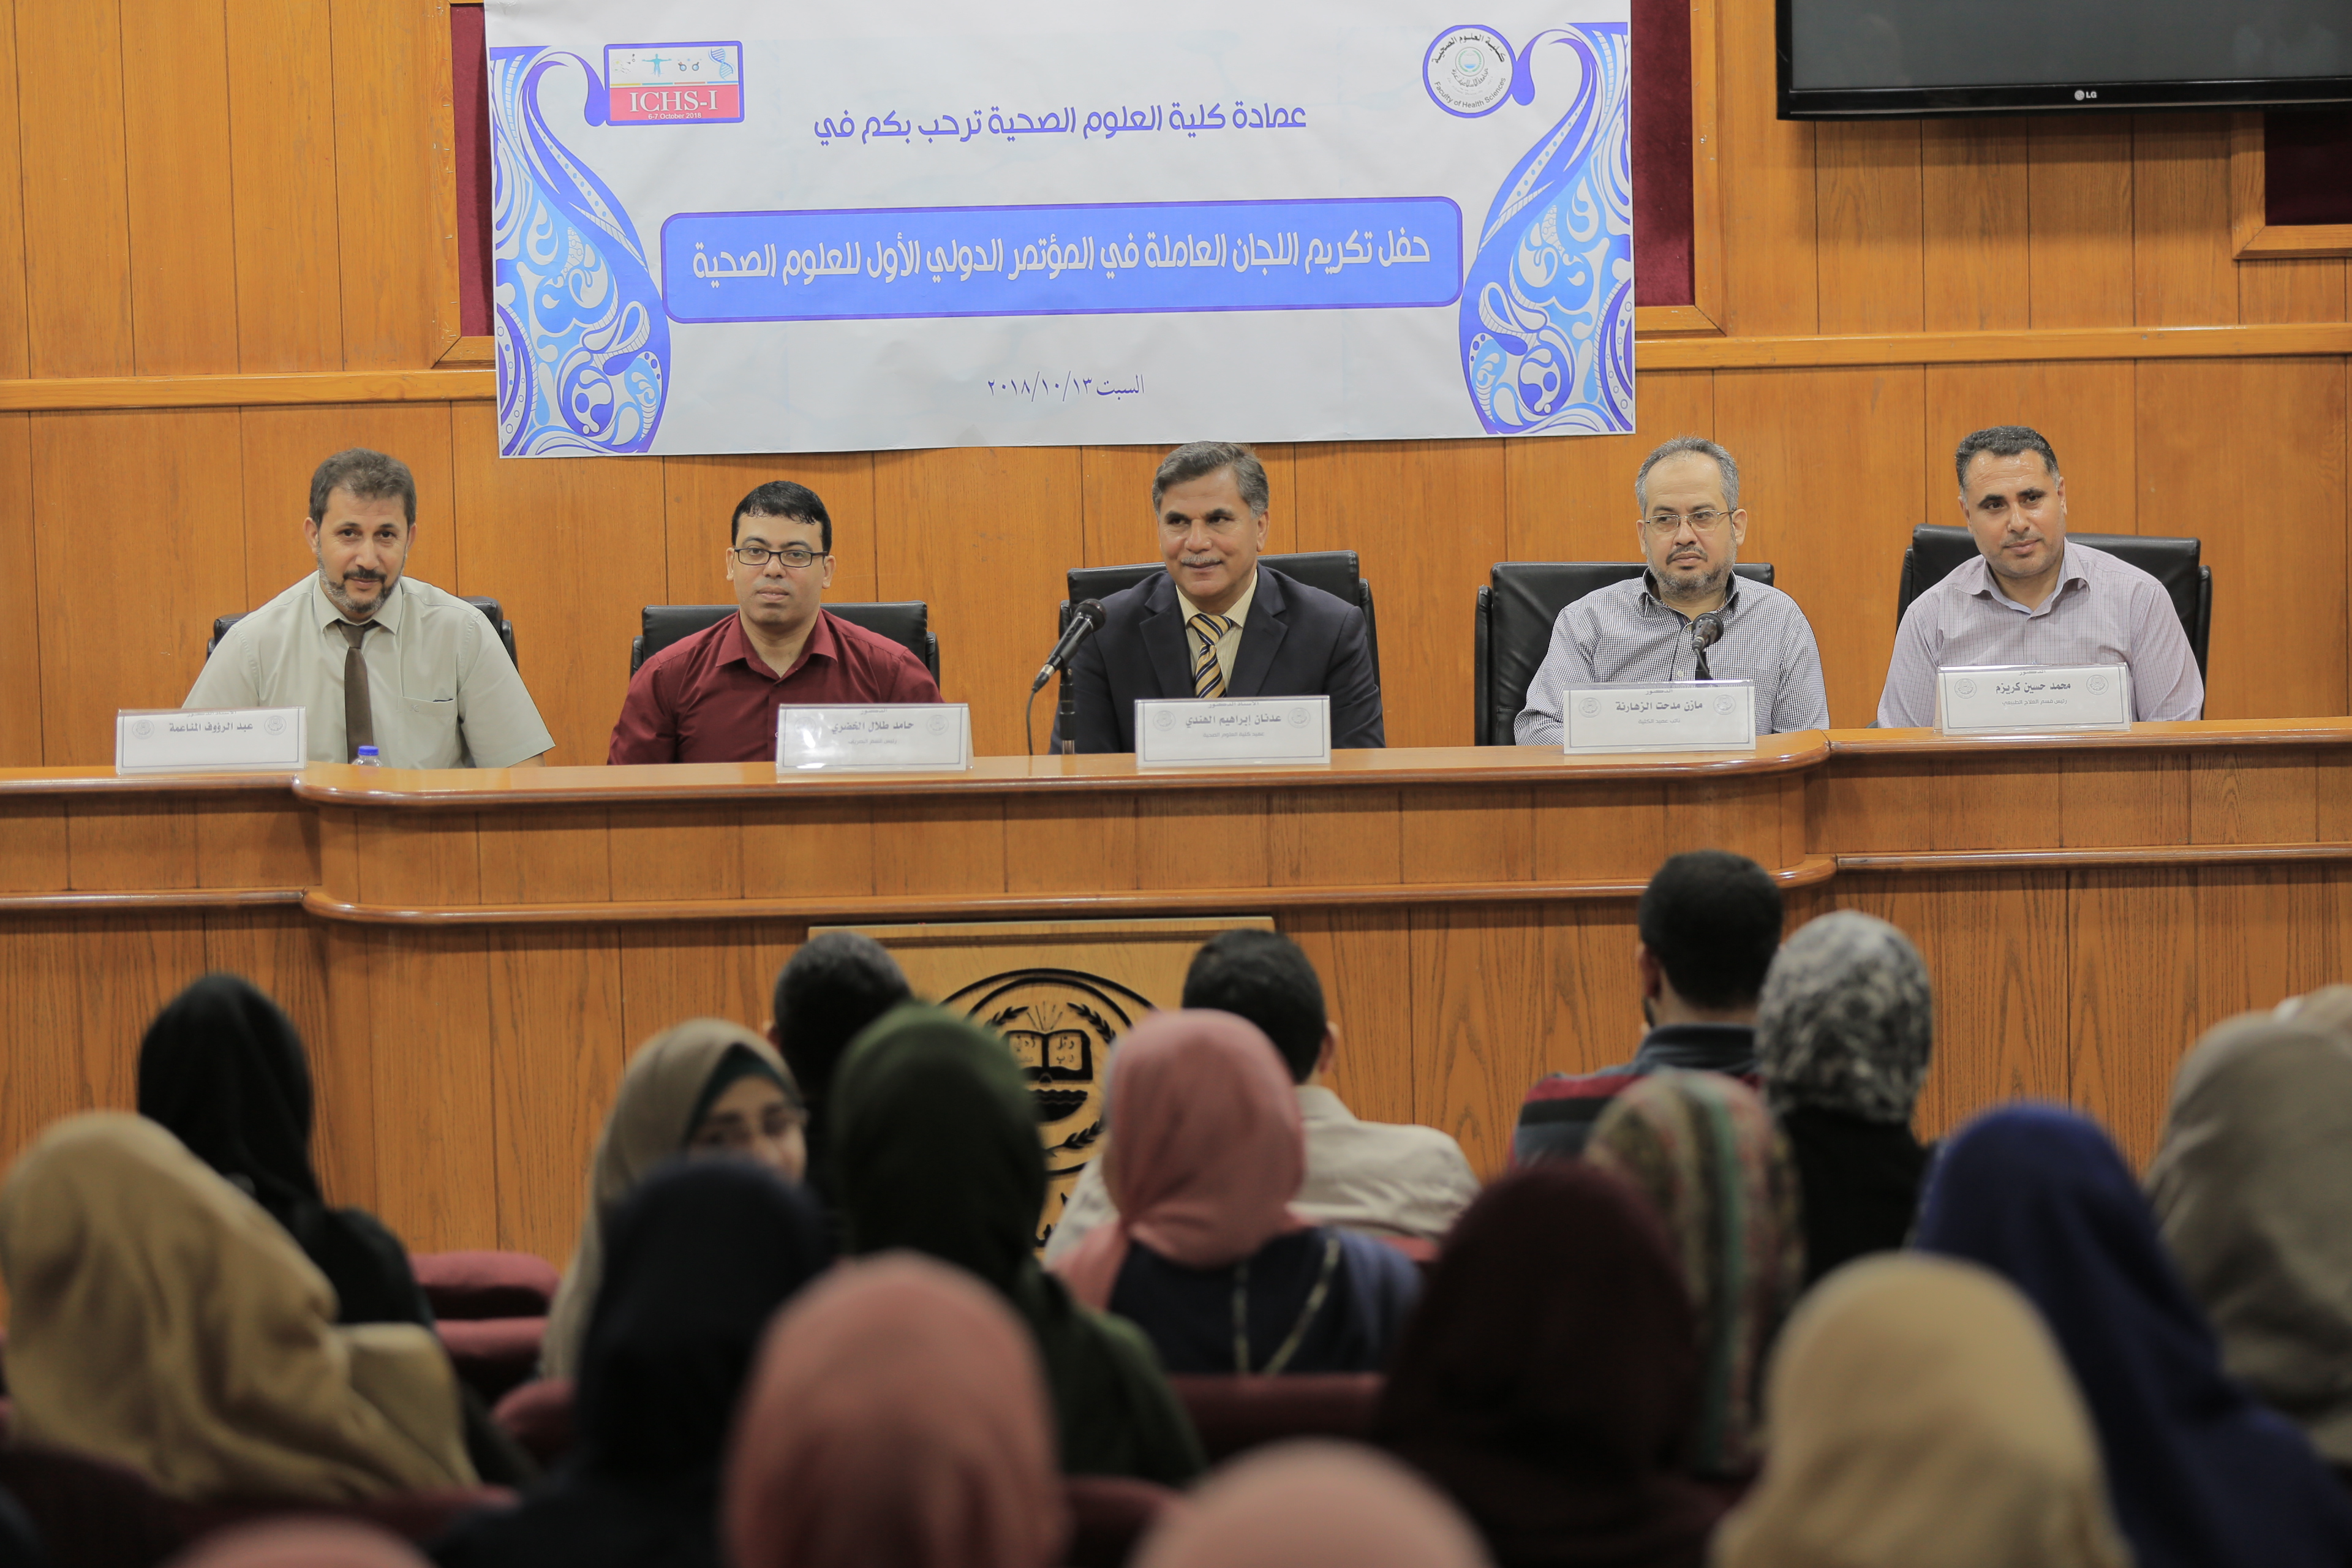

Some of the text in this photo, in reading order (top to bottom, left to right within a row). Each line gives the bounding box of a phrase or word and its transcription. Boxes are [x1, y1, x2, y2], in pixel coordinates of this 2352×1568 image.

[1431, 33, 1506, 64] كلية العلوم الصحية
[629, 90, 718, 112] ICHS-I
[1434, 81, 1453, 104] Faculty
[1462, 100, 1485, 108] Health
[1484, 78, 1506, 104] Sciences
[814, 100, 1307, 146] عمادة كلية العلوم الصحية ترحب بكم في
[693, 227, 1431, 288] حفل تكريم اللجان العاملة في المؤتمر الدولي الأول للعلوم الصحية
[1096, 374, 1145, 401] السبت
[1995, 681, 2071, 695] محمد حسين كريزم
[1615, 699, 1703, 713] مازن مدحت الزهارنة
[169, 722, 254, 734] عبد الرؤوف المناعمة
[831, 720, 914, 735] حامد طلال الخضري
[1186, 713, 1281, 728] عدنان إبراهيم الهندي
